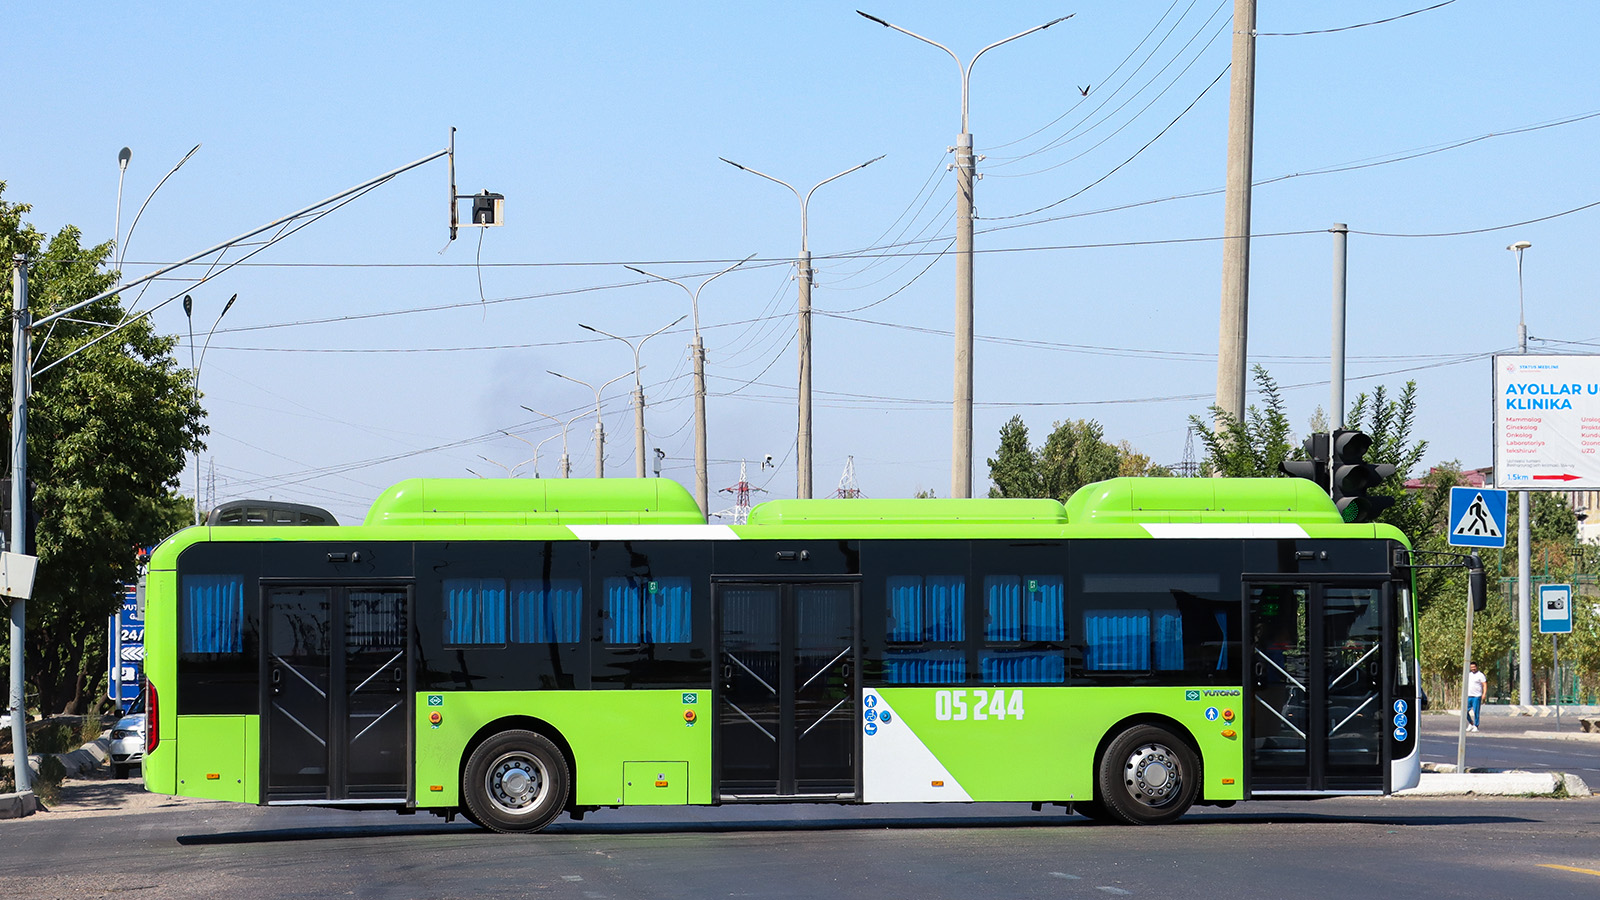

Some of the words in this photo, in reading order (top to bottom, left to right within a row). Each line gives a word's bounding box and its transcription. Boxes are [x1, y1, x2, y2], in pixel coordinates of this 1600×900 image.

[1505, 383, 1582, 395] AYOLLAR
[1587, 383, 1600, 395] U
[1506, 398, 1572, 410] KLINIKA
[1202, 689, 1241, 697] YUTONG
[935, 690, 967, 721] 05
[973, 689, 1025, 720] 244
